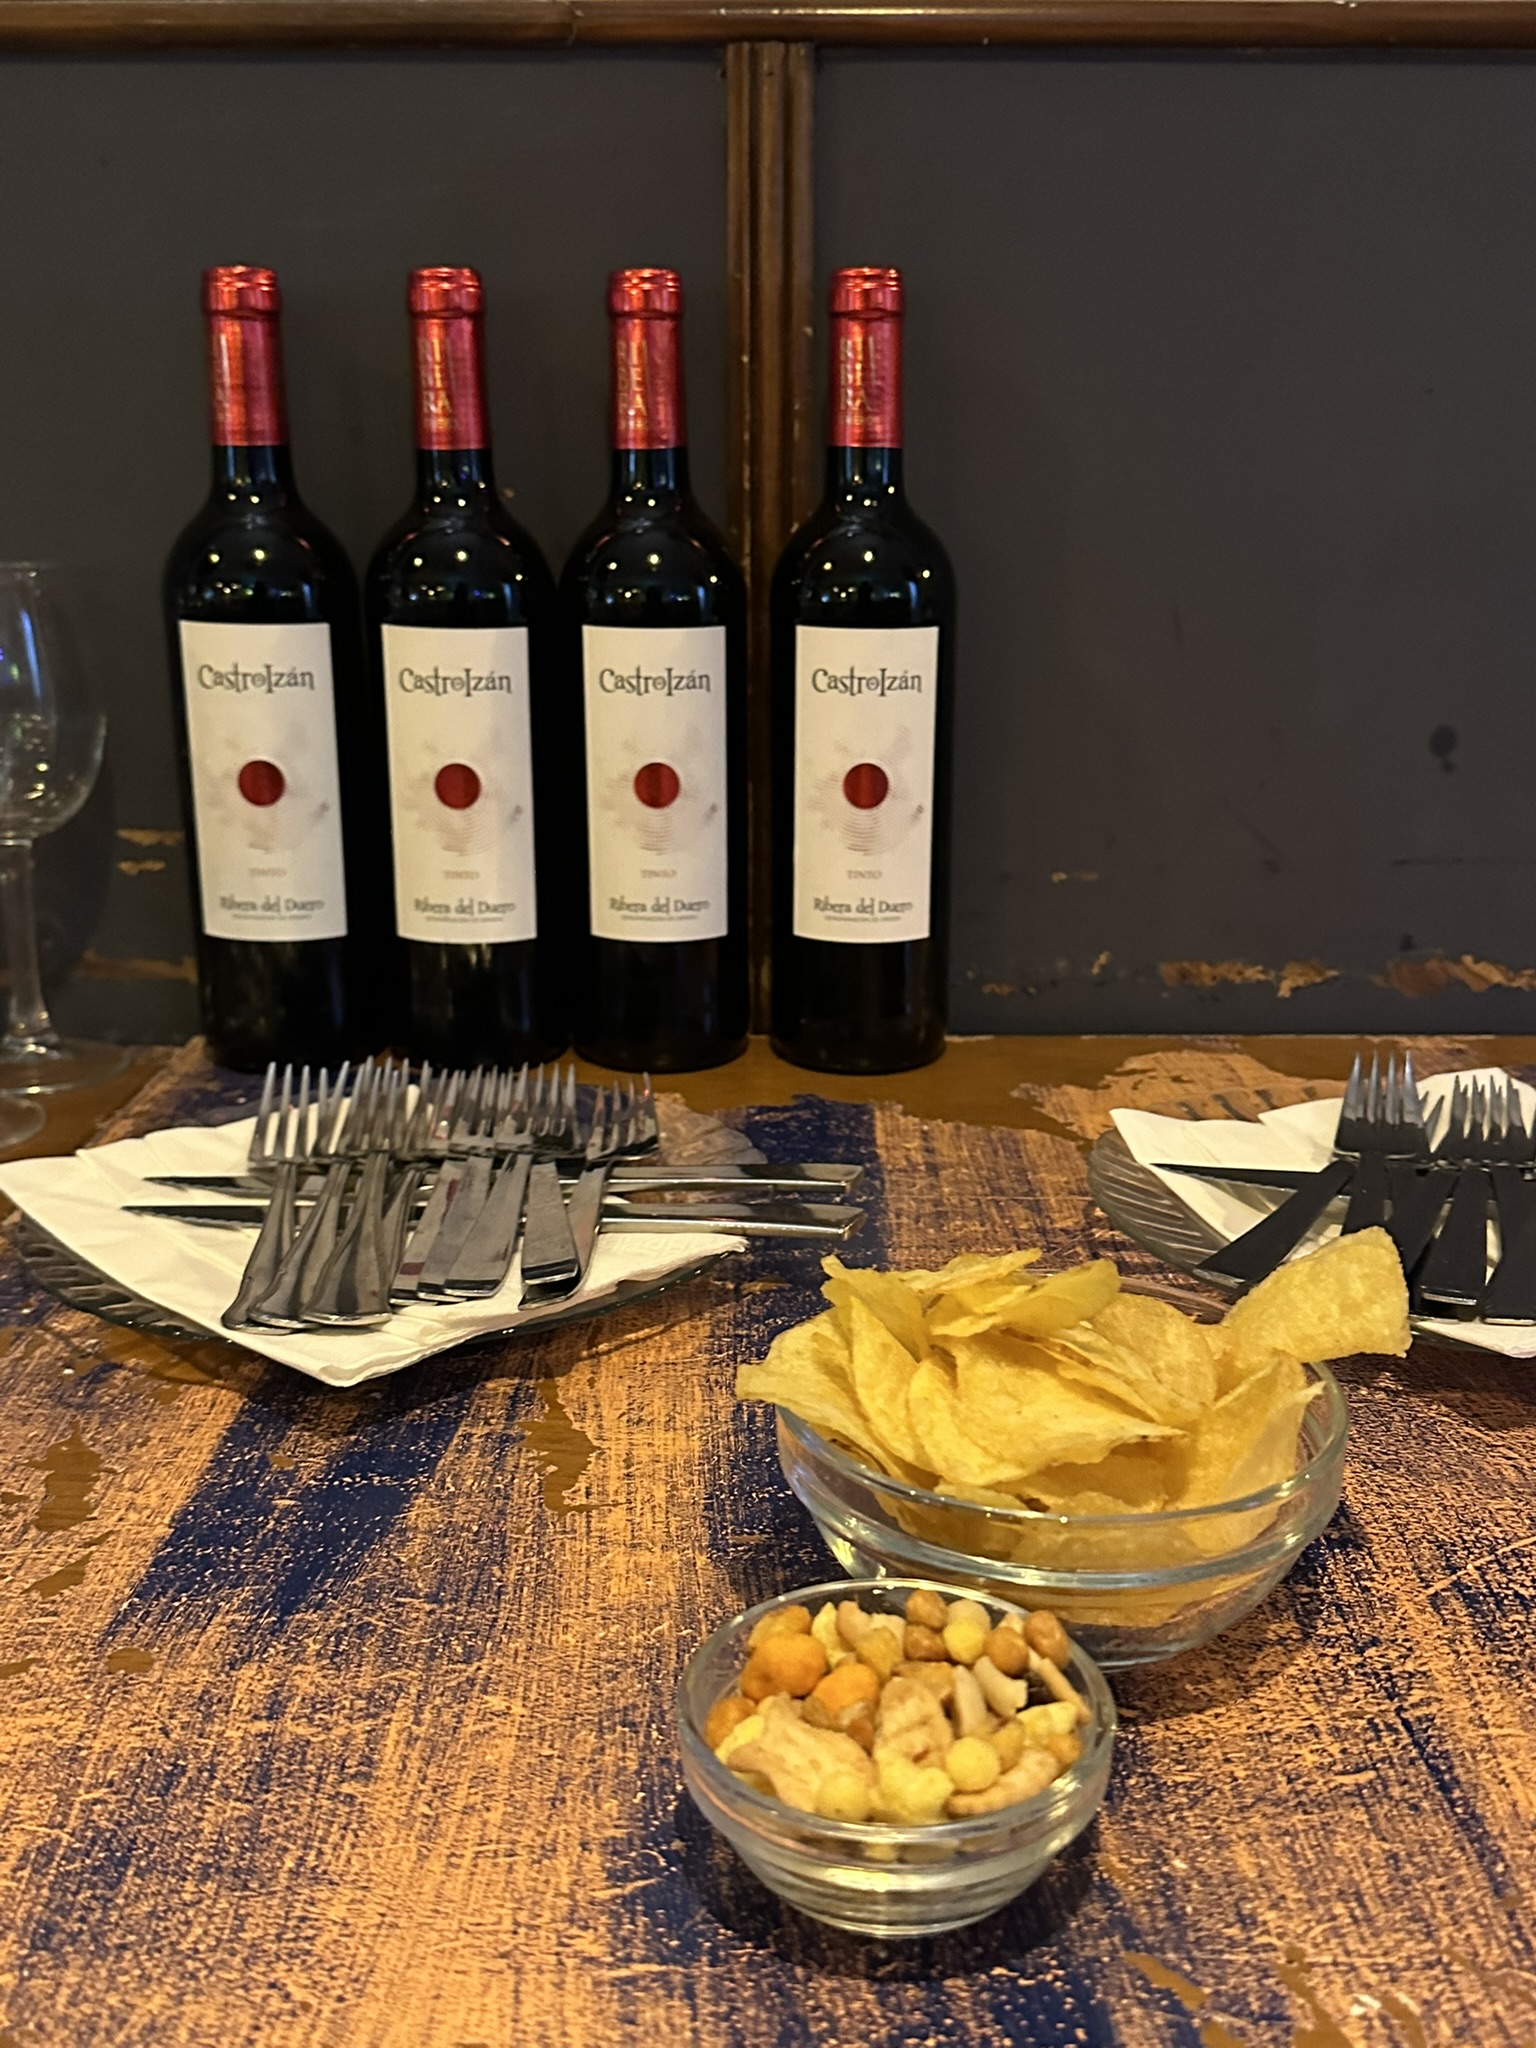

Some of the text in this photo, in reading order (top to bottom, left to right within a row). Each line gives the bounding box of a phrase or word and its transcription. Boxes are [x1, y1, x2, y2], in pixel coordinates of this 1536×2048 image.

[198, 662, 315, 695] CastroIzán
[399, 666, 512, 697] CastroIzán
[599, 665, 711, 697] CastroIzán
[811, 665, 923, 697] CastroIzán
[856, 897, 875, 916] del
